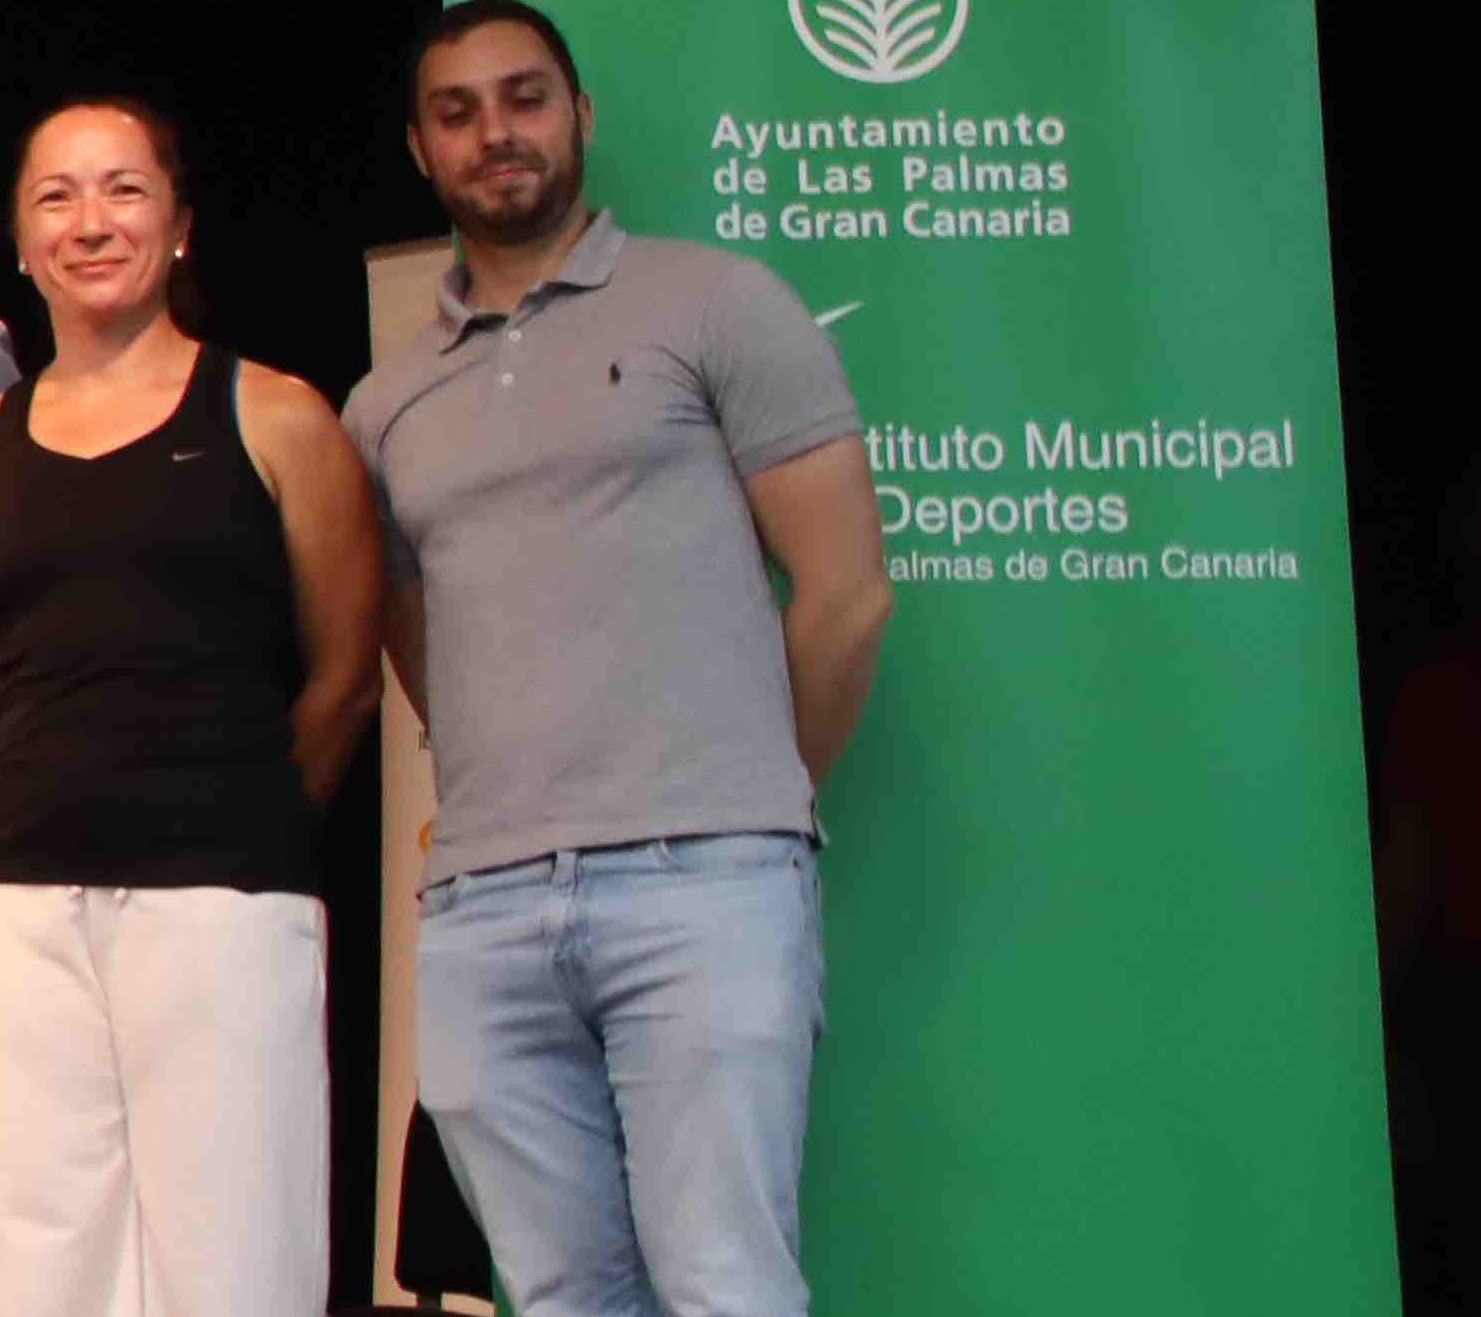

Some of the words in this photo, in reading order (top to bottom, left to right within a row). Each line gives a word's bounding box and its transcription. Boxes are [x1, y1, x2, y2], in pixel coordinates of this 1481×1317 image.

[711, 109, 1066, 156] Ayuntamiento
[713, 159, 767, 195] de
[798, 159, 873, 194] Las
[903, 154, 1069, 192] Palmas
[715, 202, 768, 240] de
[779, 202, 888, 239] Gran
[903, 199, 1071, 237] Canaria
[864, 423, 1005, 471] tituto
[1024, 419, 1294, 479] Municipal
[889, 550, 995, 581] almas
[1005, 550, 1048, 581] de
[1060, 548, 1149, 581] Gran
[1161, 545, 1299, 579] Canaria
